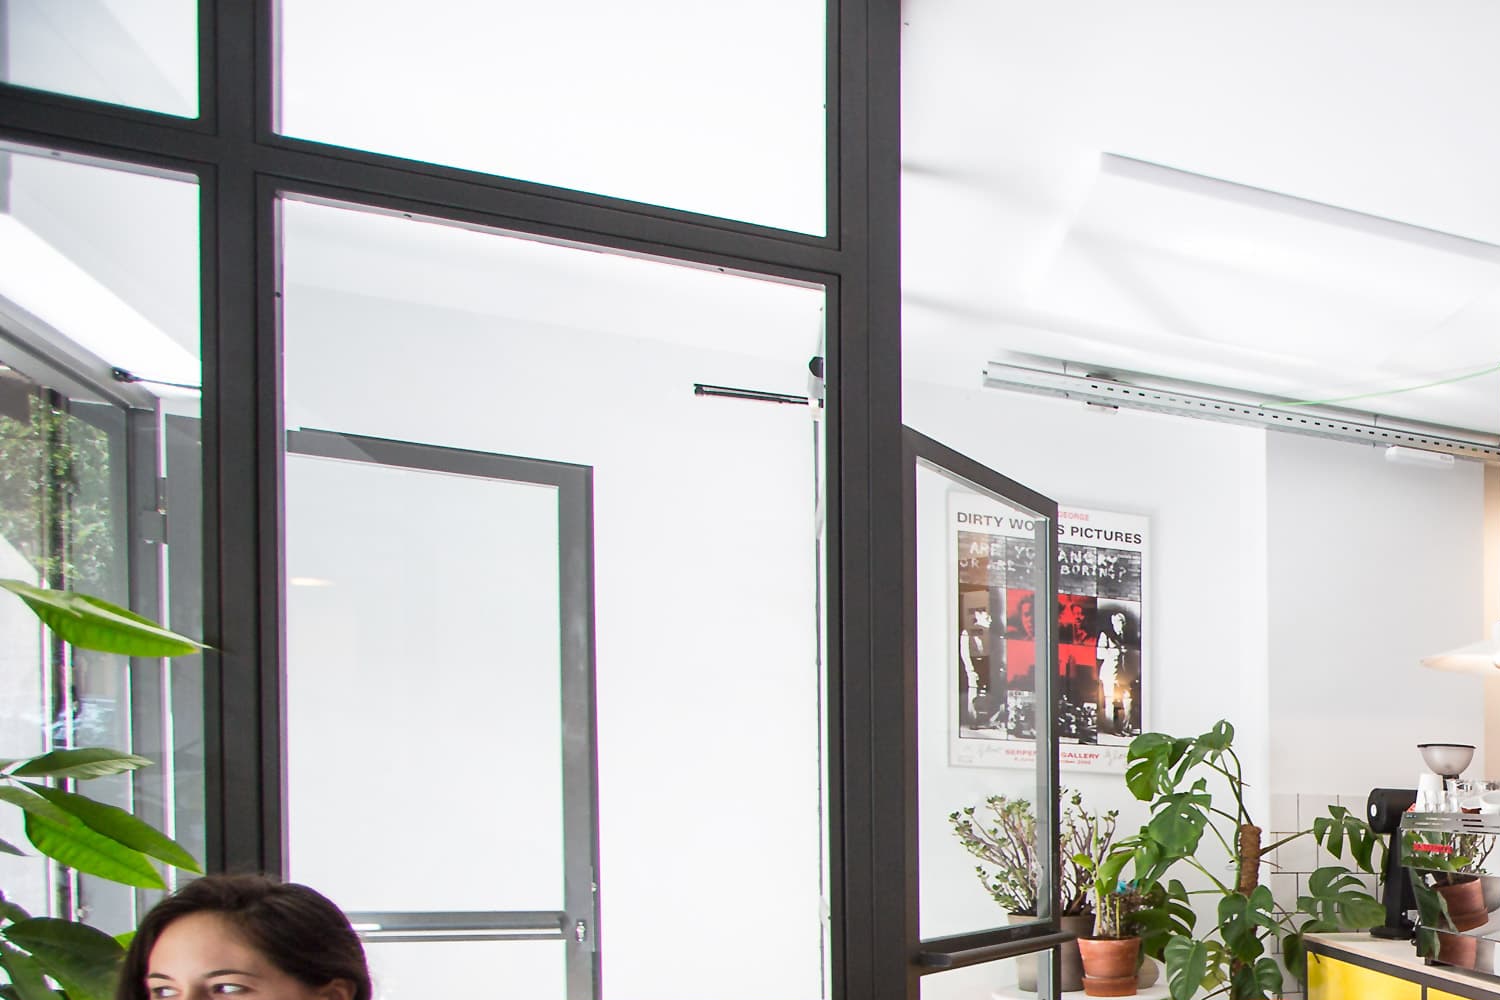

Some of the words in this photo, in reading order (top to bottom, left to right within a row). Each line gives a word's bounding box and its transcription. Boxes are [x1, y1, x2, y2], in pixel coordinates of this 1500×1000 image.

[957, 511, 1004, 527] DIRTY
[1071, 526, 1142, 544] PICTURES
[970, 541, 1002, 556] ARE
